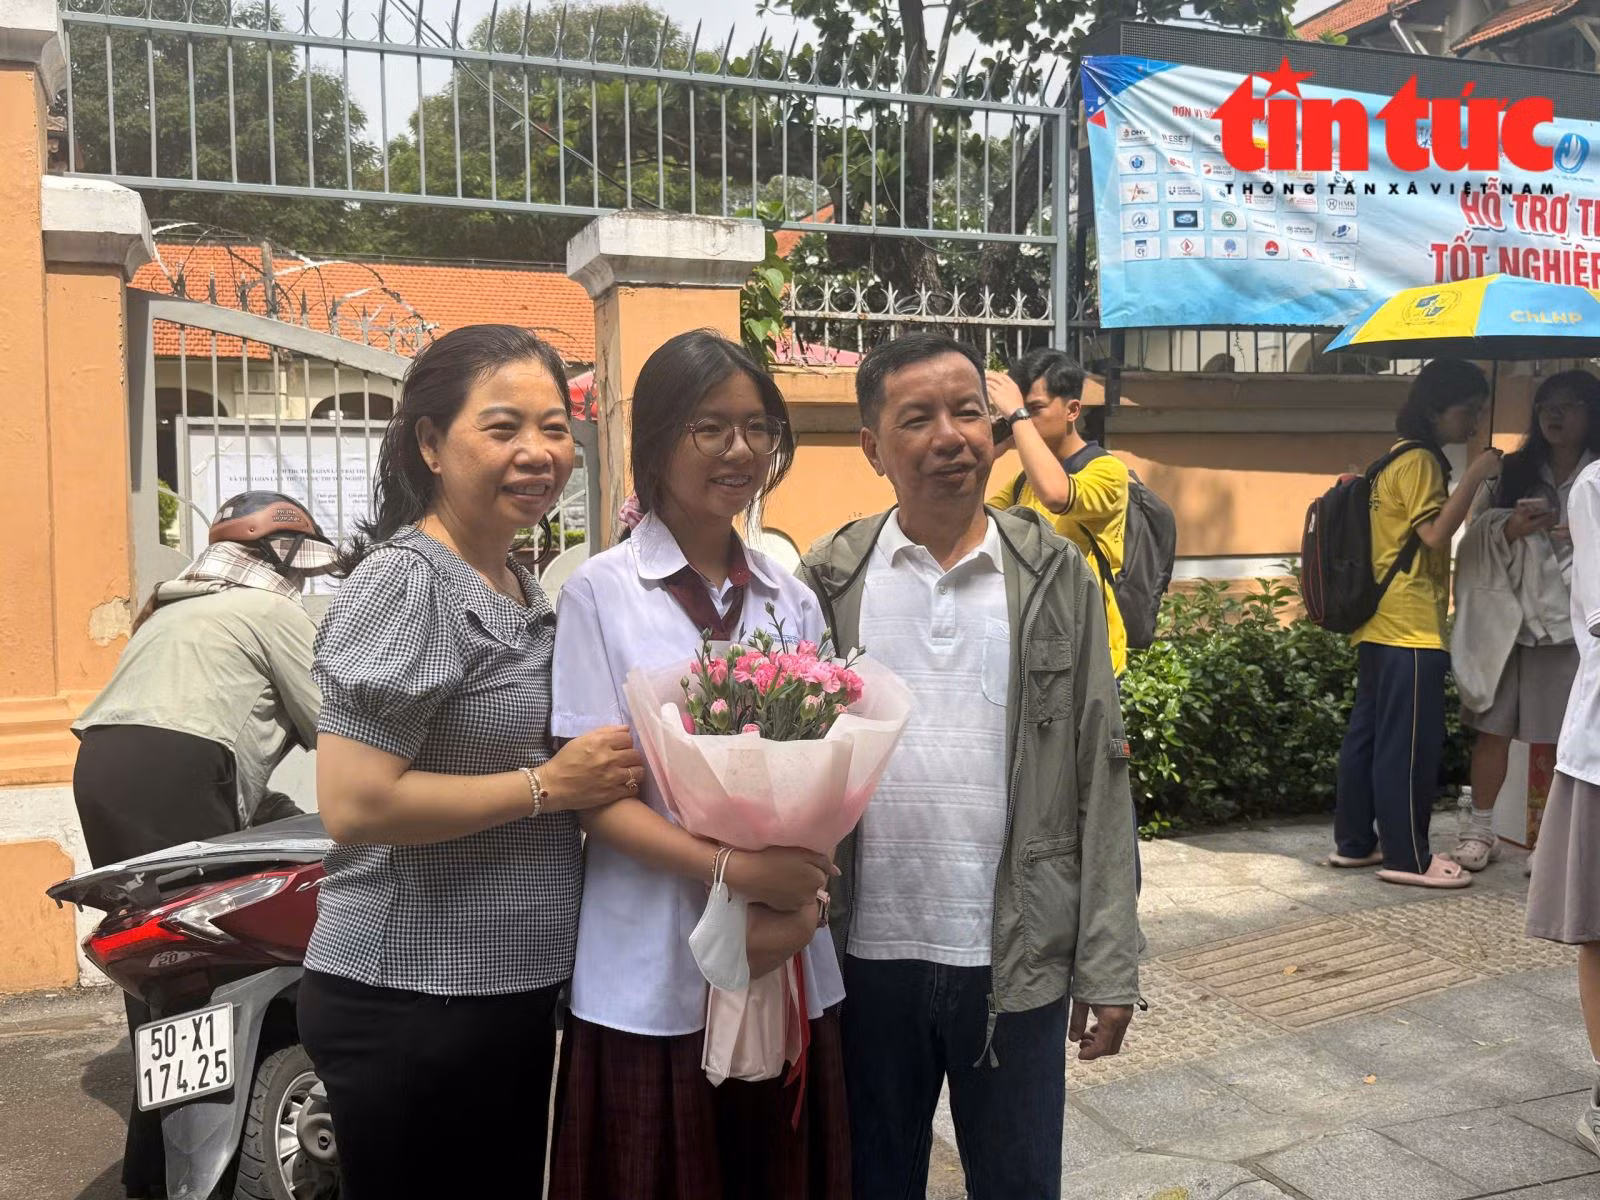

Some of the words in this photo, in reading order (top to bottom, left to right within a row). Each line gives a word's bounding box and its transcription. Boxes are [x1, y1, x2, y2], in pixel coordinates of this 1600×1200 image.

[1460, 177, 1505, 230] HỖ
[1512, 193, 1571, 240] TRỢ
[1430, 230, 1488, 284] TỐT
[151, 1013, 214, 1061] 50-X1
[144, 1048, 227, 1102] 174.25
